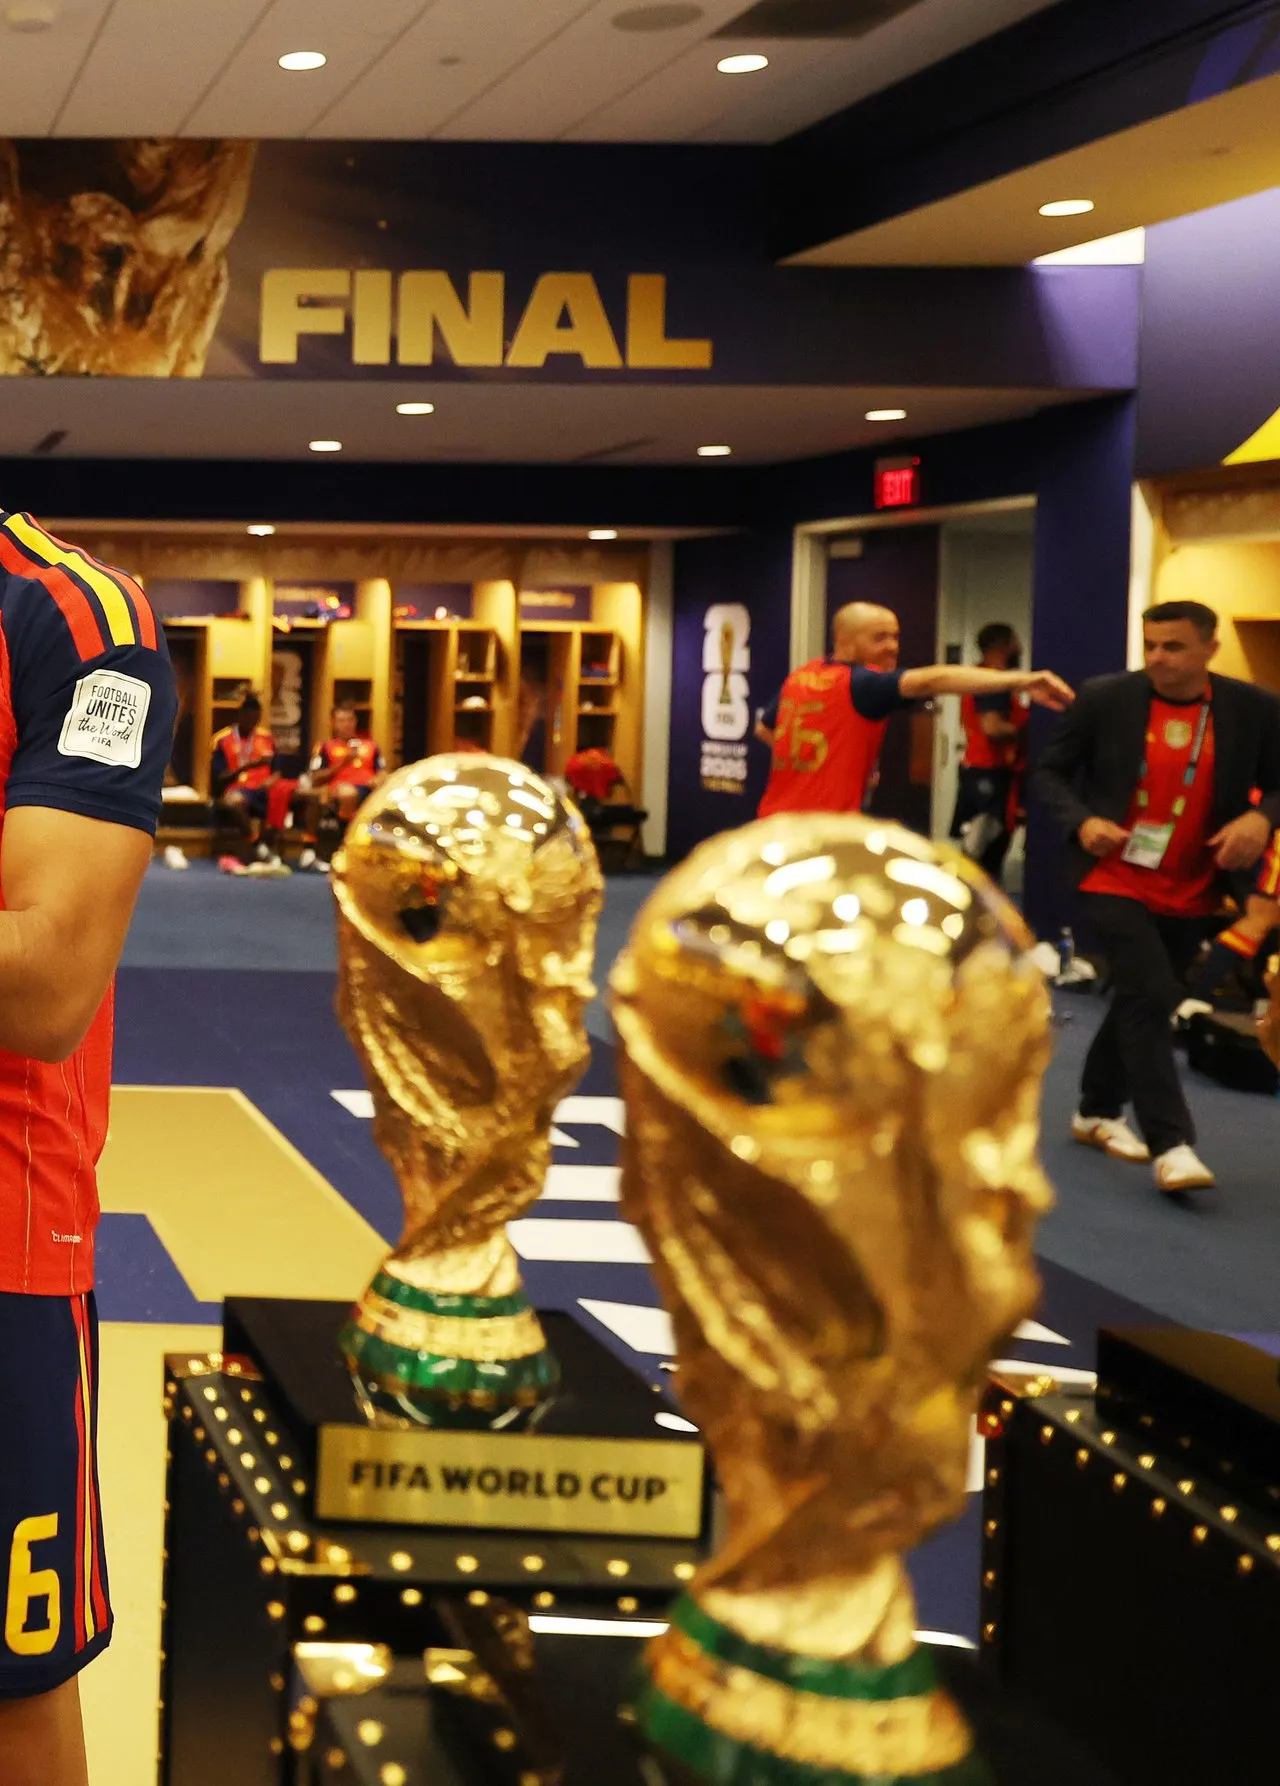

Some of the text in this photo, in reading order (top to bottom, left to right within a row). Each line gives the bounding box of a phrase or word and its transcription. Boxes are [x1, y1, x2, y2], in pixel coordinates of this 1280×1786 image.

[259, 269, 713, 369] FINAL
[91, 685, 138, 708] FOOTBALL
[86, 699, 136, 725] UNITES
[78, 717, 133, 744] the World
[91, 736, 112, 747] FIFA
[352, 1460, 667, 1504] FIFA WORLD CUP
[4, 1511, 61, 1656] 6
